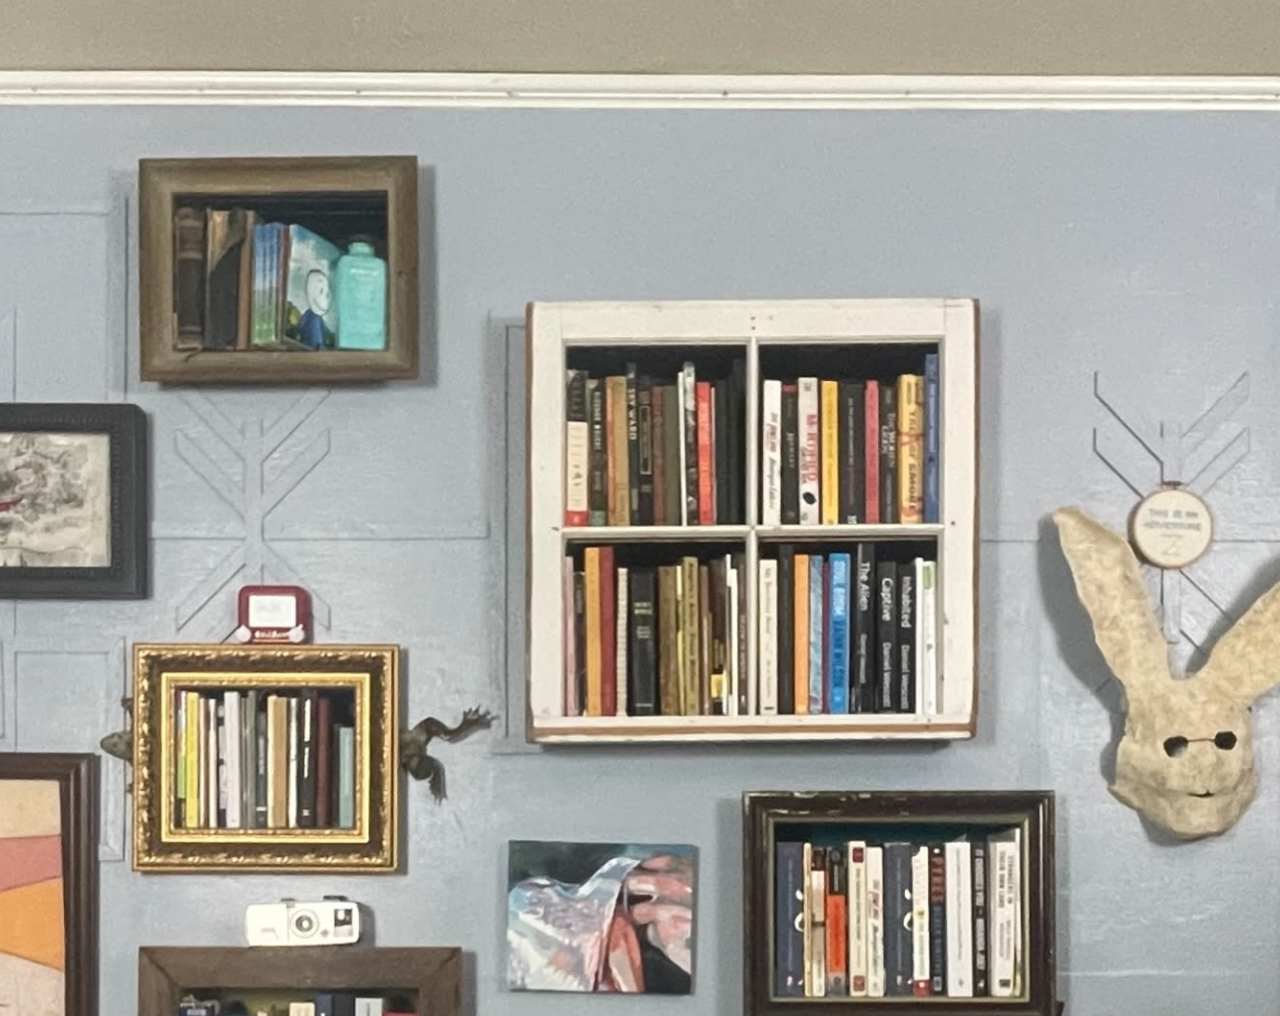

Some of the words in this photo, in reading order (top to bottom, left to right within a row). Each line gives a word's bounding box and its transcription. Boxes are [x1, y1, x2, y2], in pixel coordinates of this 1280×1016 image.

[860, 561, 870, 581] The
[860, 583, 870, 611] Alien
[881, 578, 893, 621] Captive
[901, 576, 912, 628] Inhabited
